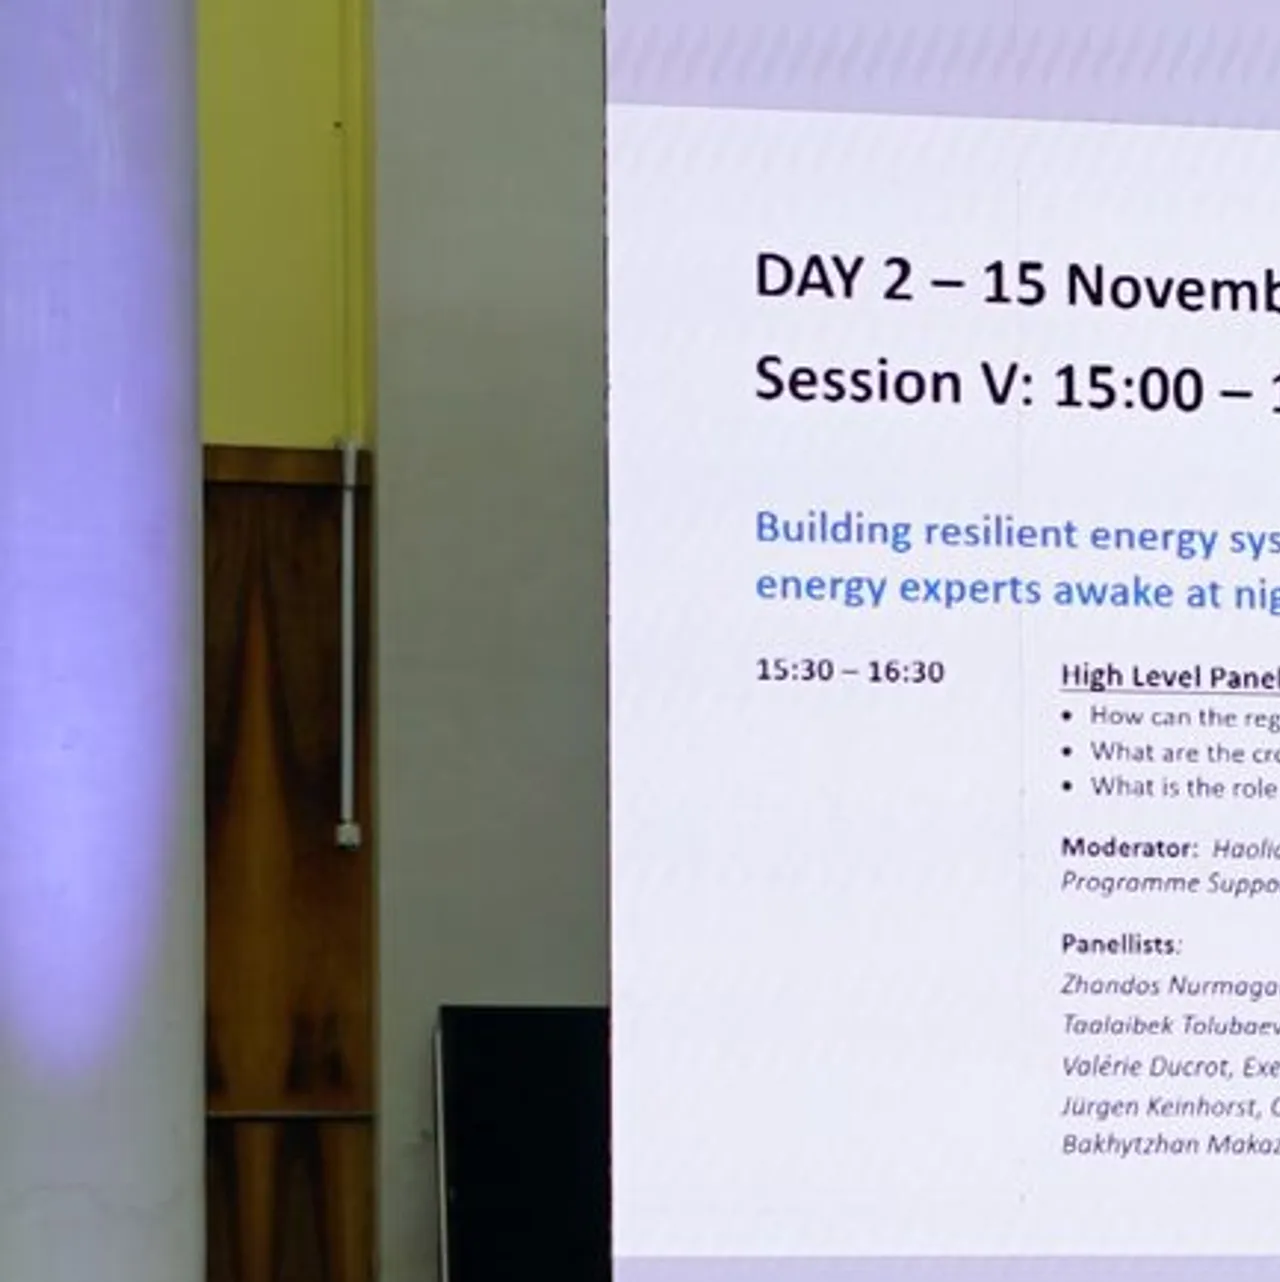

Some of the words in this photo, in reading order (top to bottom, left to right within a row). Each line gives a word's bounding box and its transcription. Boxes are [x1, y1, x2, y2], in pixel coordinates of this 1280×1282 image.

[755, 250, 867, 301] DAY
[882, 255, 915, 303] 2
[983, 259, 1048, 308] 15
[755, 353, 962, 407] Session
[979, 359, 1034, 407] V:
[1054, 362, 1205, 415] 15:00
[755, 509, 913, 555] Building
[924, 513, 1079, 550] resilient
[1089, 526, 1220, 562] energy
[755, 574, 888, 609] energy
[898, 575, 1042, 610] experts
[1052, 573, 1175, 609] awake
[1186, 580, 1224, 610] at
[755, 657, 835, 683] 15:30
[867, 658, 946, 685] 16:30
[1061, 660, 1124, 690] High
[1131, 663, 1202, 691] Level
[1089, 703, 1145, 726] How
[1149, 711, 1192, 727] can
[1198, 706, 1239, 729] the
[1089, 739, 1156, 764] What
[1161, 746, 1201, 764] are
[1206, 741, 1246, 765] the
[1089, 774, 1155, 799] What
[1186, 775, 1227, 799] the
[1231, 776, 1279, 801] role
[1060, 834, 1200, 860] Moderator:
[1060, 868, 1202, 899] Programme
[1061, 931, 1183, 956] Panellists:
[1059, 971, 1161, 997] Zhandos
[1064, 1012, 1175, 1037] Taalaibek
[1062, 1053, 1144, 1079] Valérie
[1148, 1054, 1235, 1082] Ducrot,
[1060, 1096, 1140, 1122] Jürgen
[1145, 1094, 1263, 1122] Keinhorst,
[1062, 1131, 1201, 1160] Bakhytzhan
